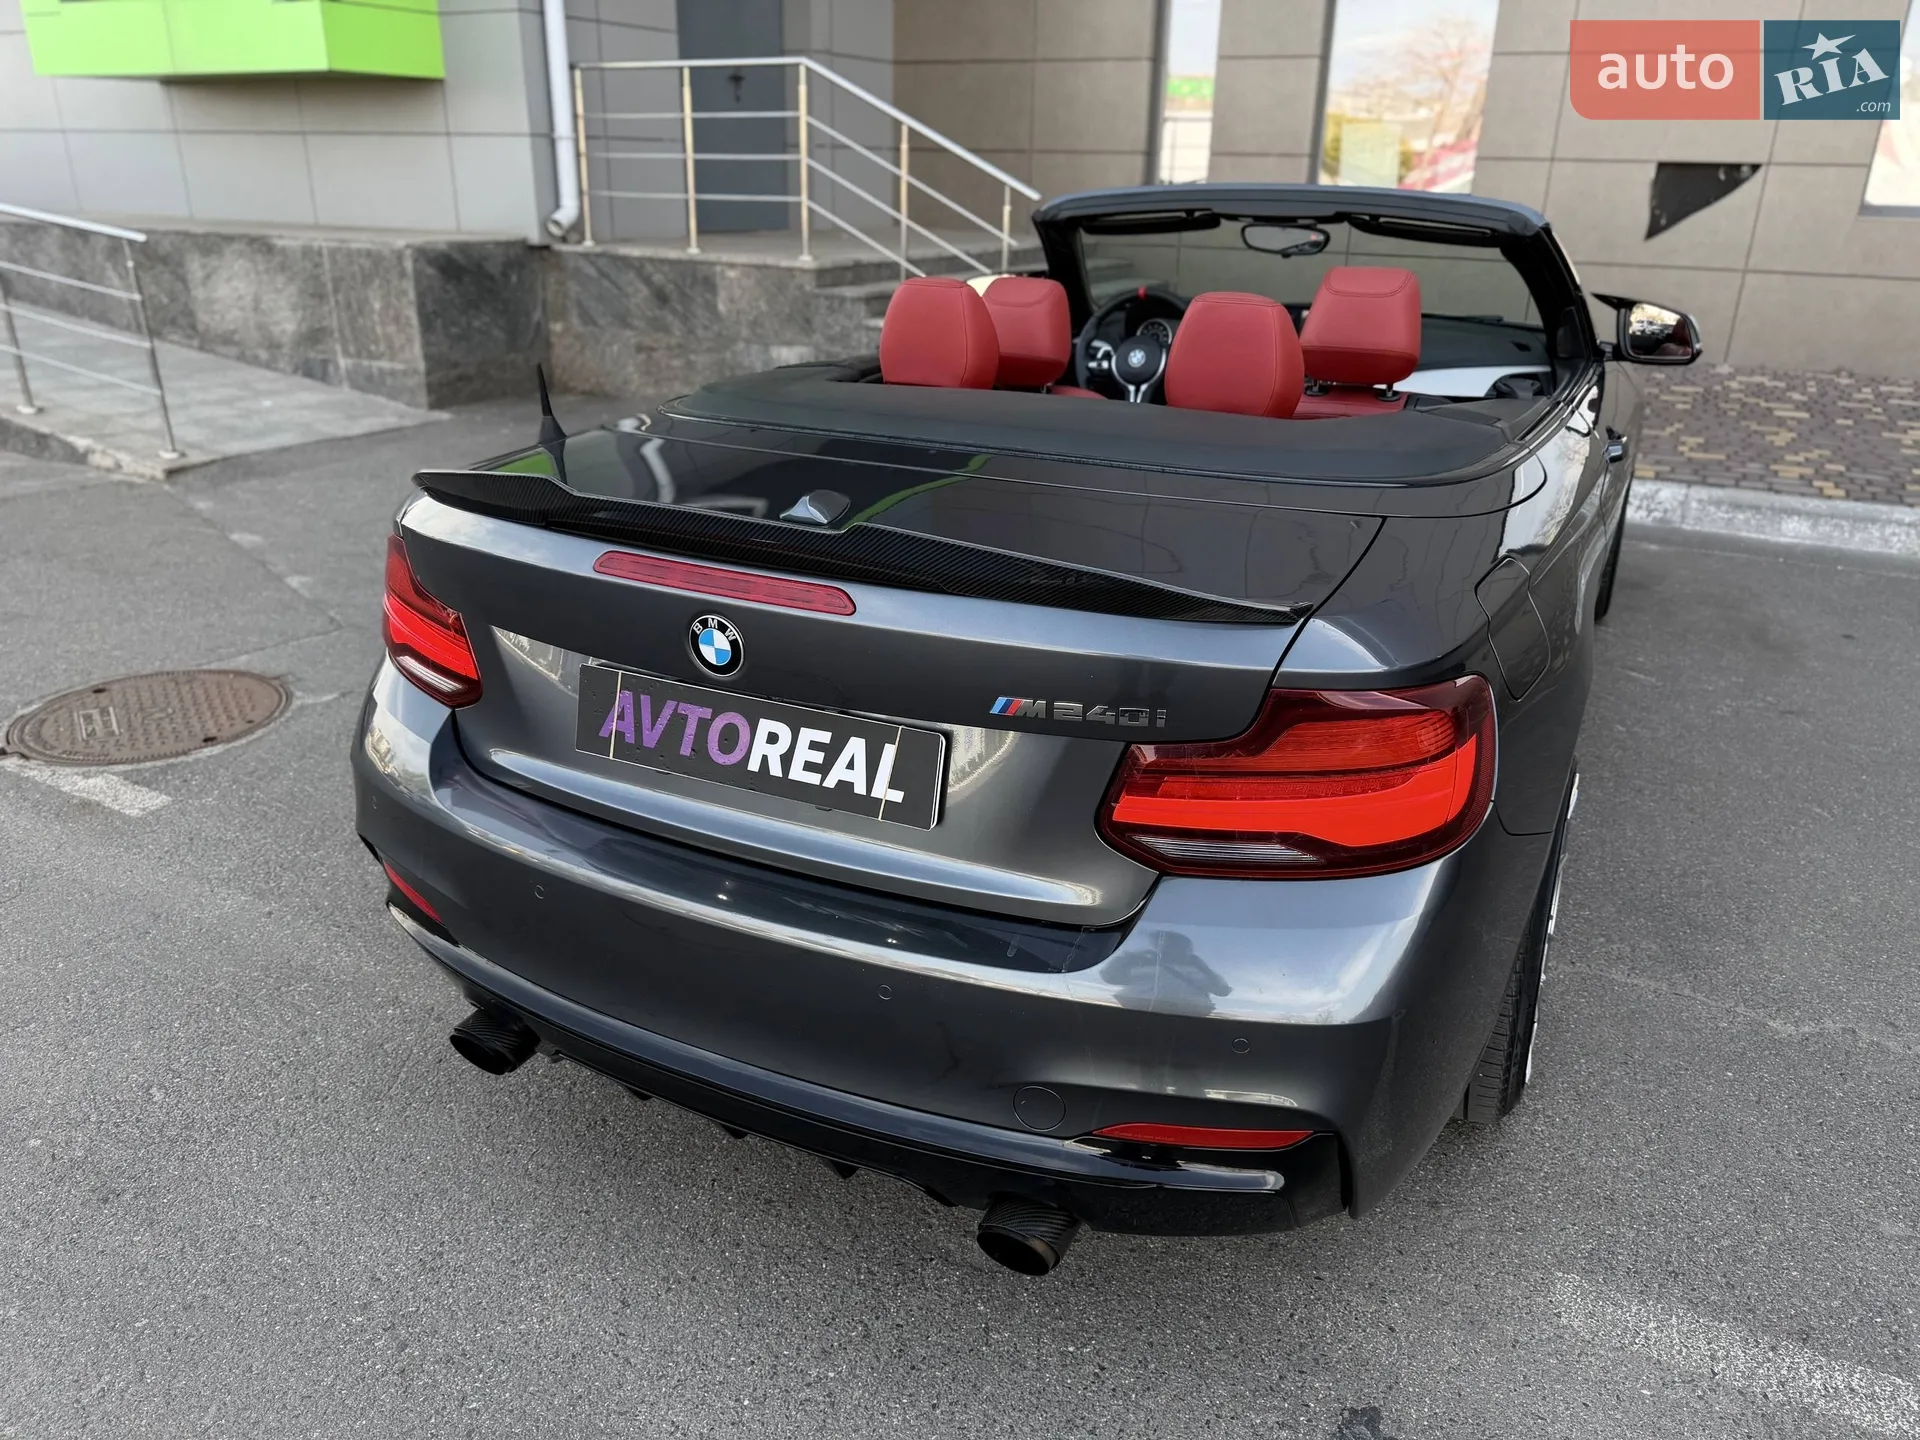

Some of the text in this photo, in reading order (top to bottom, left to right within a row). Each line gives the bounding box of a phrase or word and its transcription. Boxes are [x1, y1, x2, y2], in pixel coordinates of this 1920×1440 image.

[693, 617, 737, 642] BMW
[1012, 699, 1167, 728] M240i
[598, 689, 905, 804] AVTOREAL
